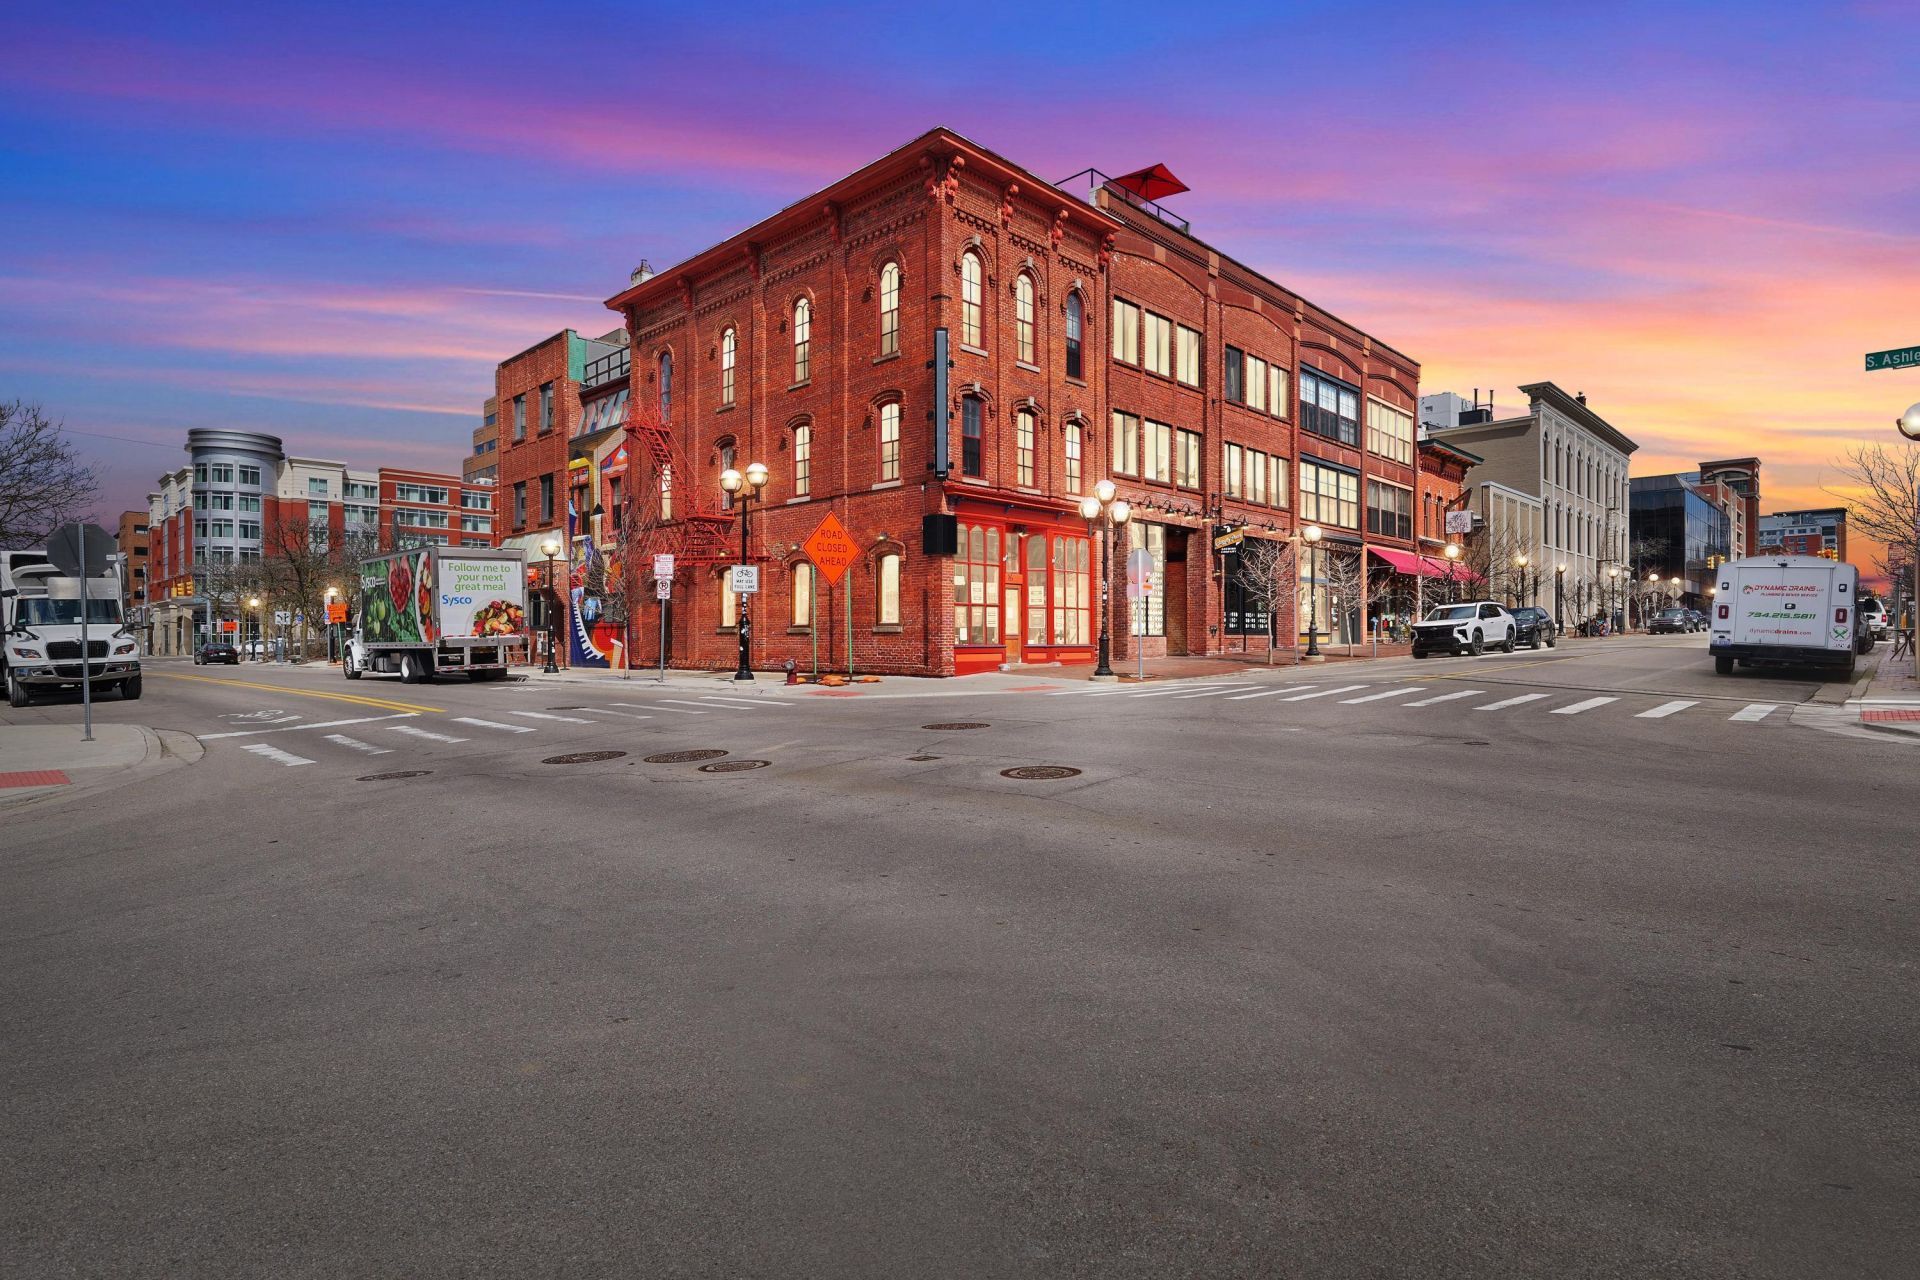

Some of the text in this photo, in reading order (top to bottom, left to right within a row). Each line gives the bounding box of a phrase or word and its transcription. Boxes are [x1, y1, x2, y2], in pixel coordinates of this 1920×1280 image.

[1866, 350, 1920, 368] S. Ashle
[820, 529, 843, 540] ROAD
[816, 542, 848, 553] CLOSED
[820, 556, 847, 567] AHEAD
[448, 562, 481, 572] Follow
[500, 564, 511, 573] to
[361, 574, 376, 591] Sysco
[456, 573, 504, 583] your next
[454, 582, 506, 593] great meal
[1754, 584, 1788, 592] DYNAMIC
[442, 594, 472, 606] Sysco
[1749, 628, 1812, 636] dynamicdrains.com
